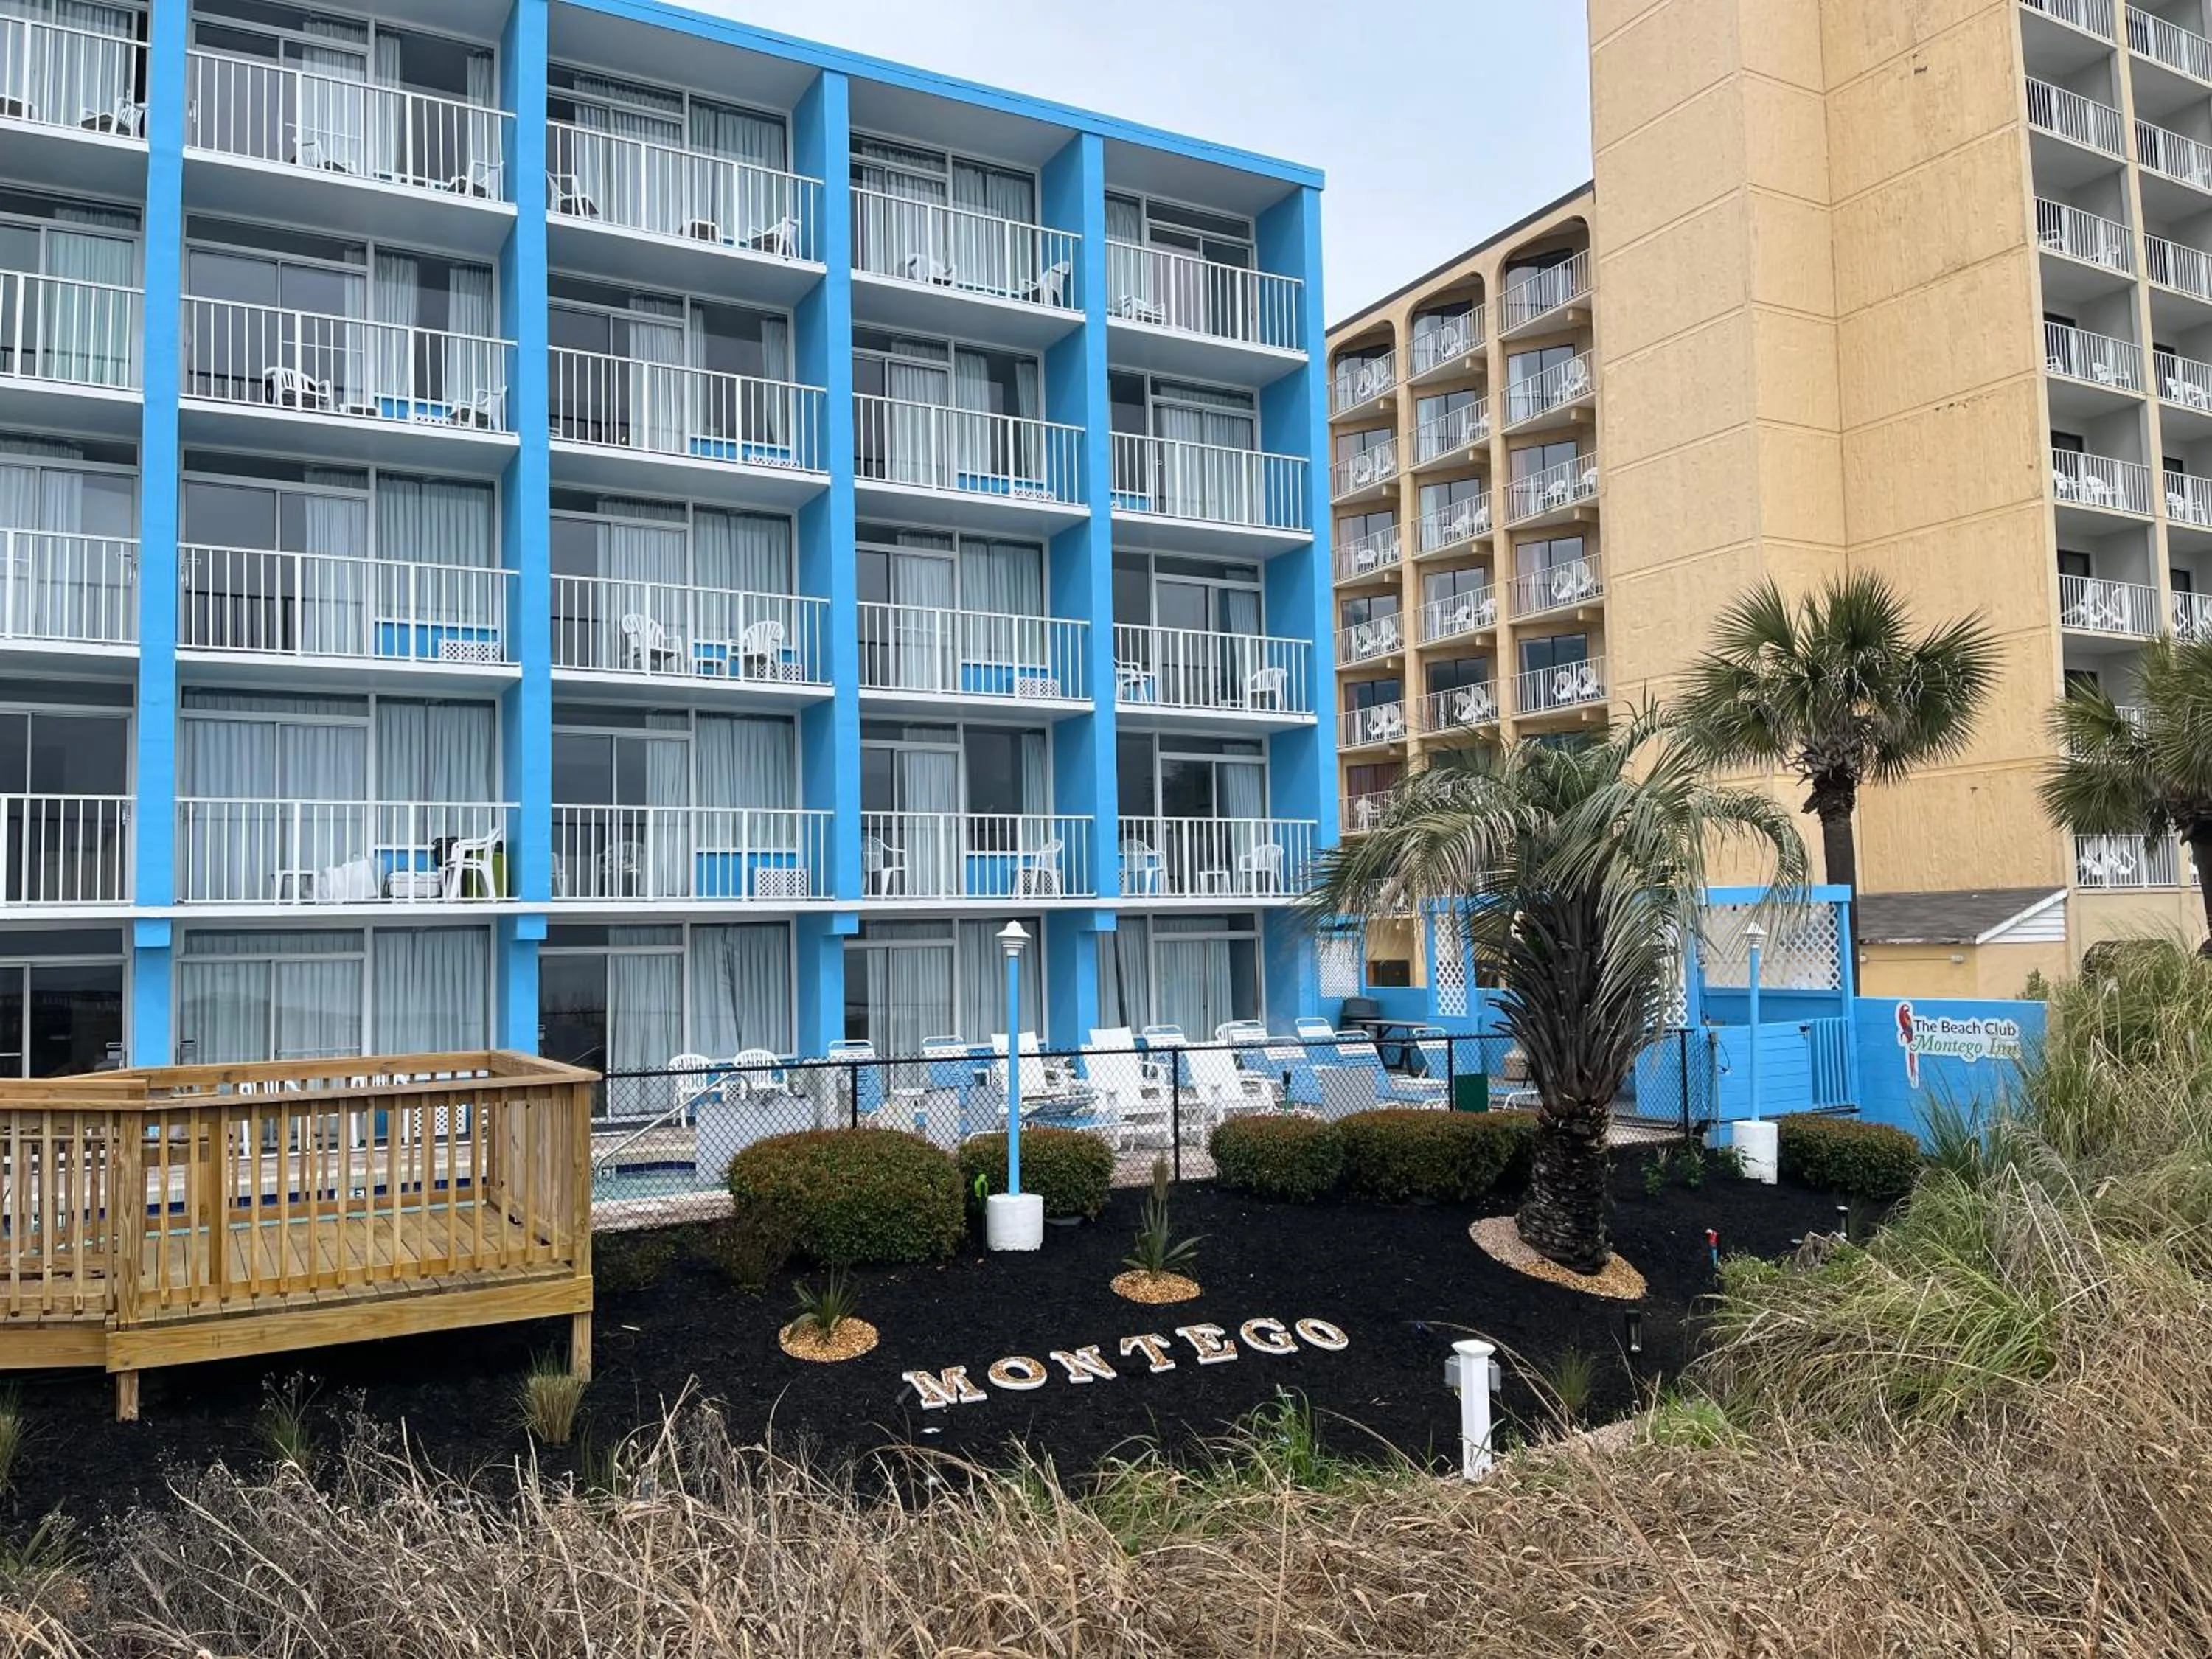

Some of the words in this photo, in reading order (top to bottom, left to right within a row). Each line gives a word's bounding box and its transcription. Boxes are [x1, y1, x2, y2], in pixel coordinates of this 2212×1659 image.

[1913, 1020, 1937, 1033] The
[1941, 1020, 1981, 1034] Beach
[1985, 1022, 2016, 1036] Club
[1910, 1034, 1983, 1059] Montego
[902, 1317, 1349, 1410] MONTEGO
